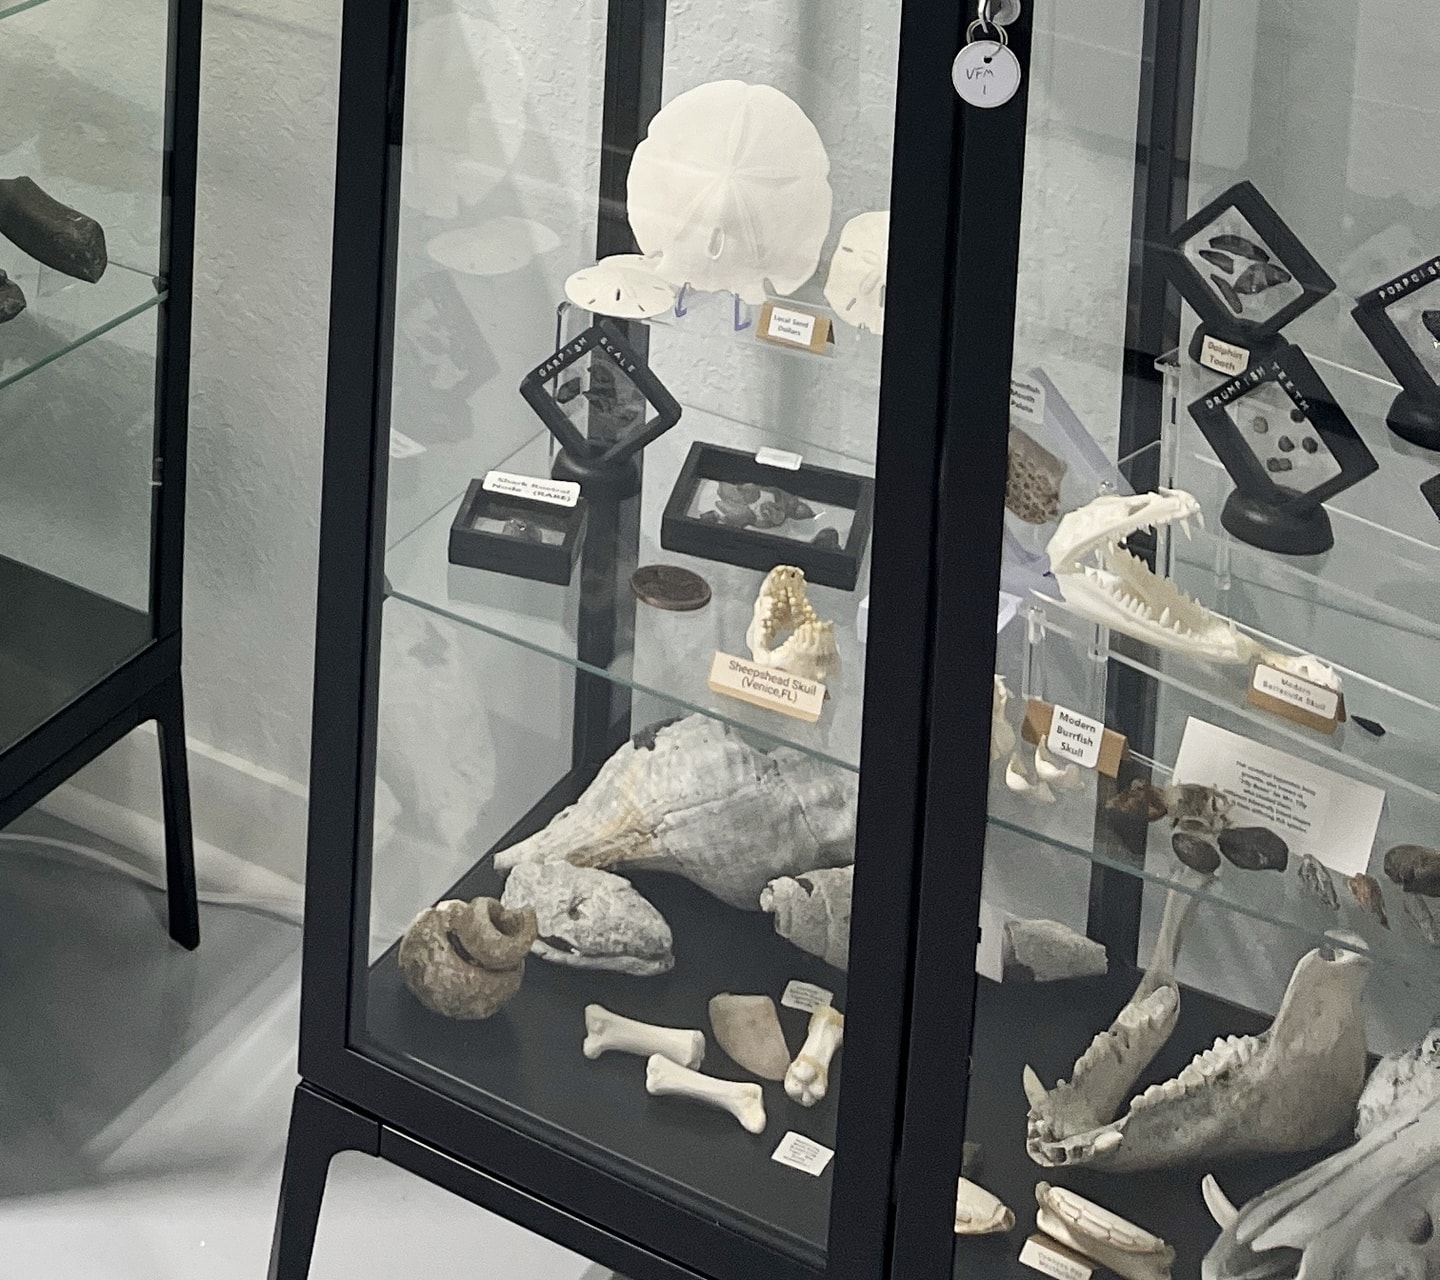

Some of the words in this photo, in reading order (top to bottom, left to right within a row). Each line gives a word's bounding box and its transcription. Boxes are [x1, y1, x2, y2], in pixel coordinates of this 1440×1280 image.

[599, 336, 637, 374] SCALE
[728, 660, 790, 687] Sheepshead
[792, 679, 817, 697] Skull
[1059, 711, 1097, 734] Modern
[1055, 725, 1095, 748] Burrfish
[1059, 741, 1085, 759] Skull
